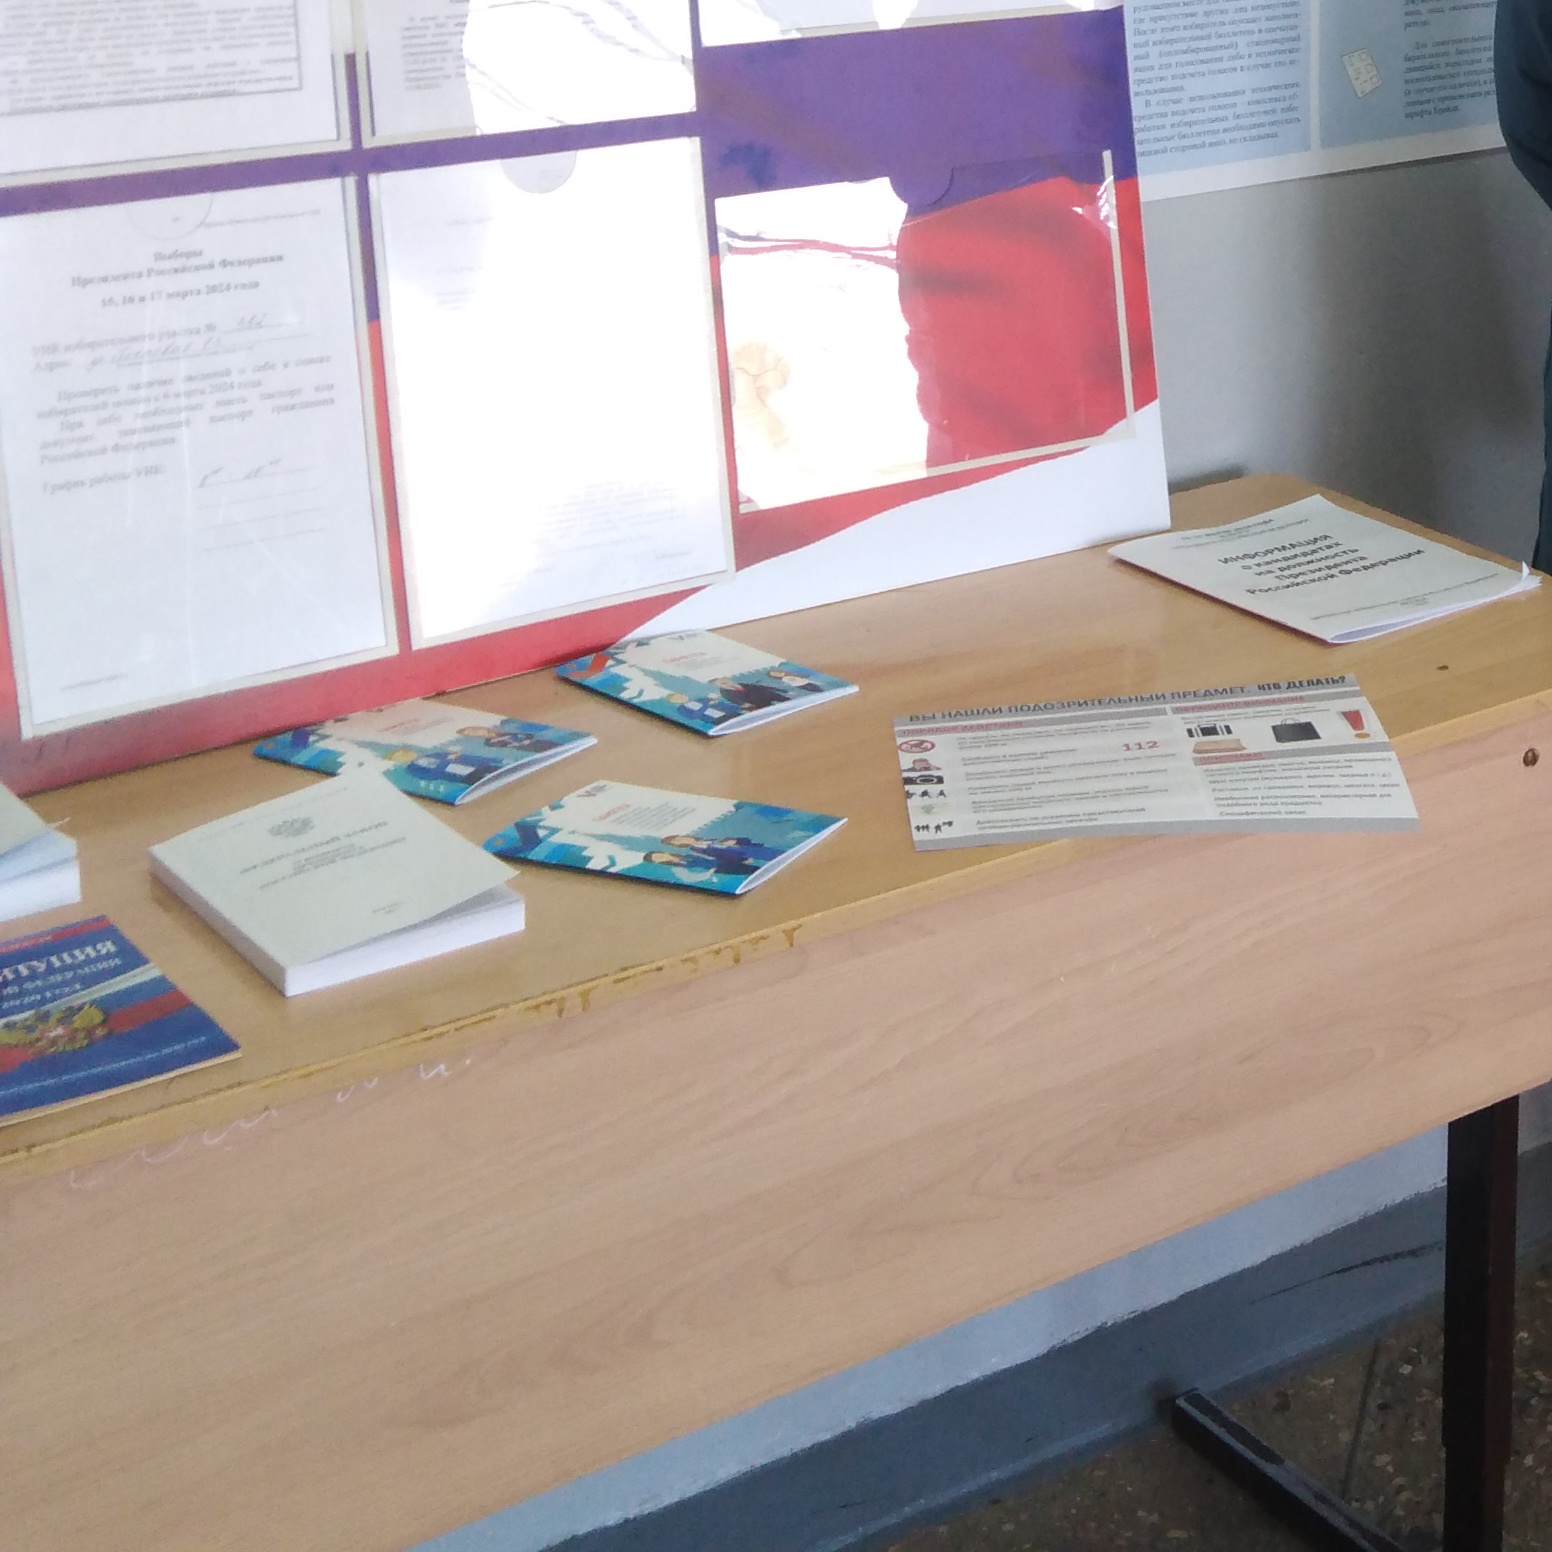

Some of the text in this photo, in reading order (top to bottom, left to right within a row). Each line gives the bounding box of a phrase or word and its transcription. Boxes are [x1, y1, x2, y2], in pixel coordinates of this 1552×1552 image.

[1217, 533, 1333, 566] ИНФОРМАЦИЯ
[1254, 540, 1343, 568] кандидатах
[1273, 547, 1360, 574] должность
[1245, 548, 1425, 596] Российской Федерации
[1274, 555, 1368, 583] Президента
[941, 704, 1003, 720] НАШЛИ
[1007, 691, 1167, 715] ПОДОЗРИТЕЛЬНЫЙ
[1257, 682, 1281, 692] ЧТО
[1285, 675, 1346, 691] ДЕЛАТЬ?
[1121, 740, 1160, 752] 112
